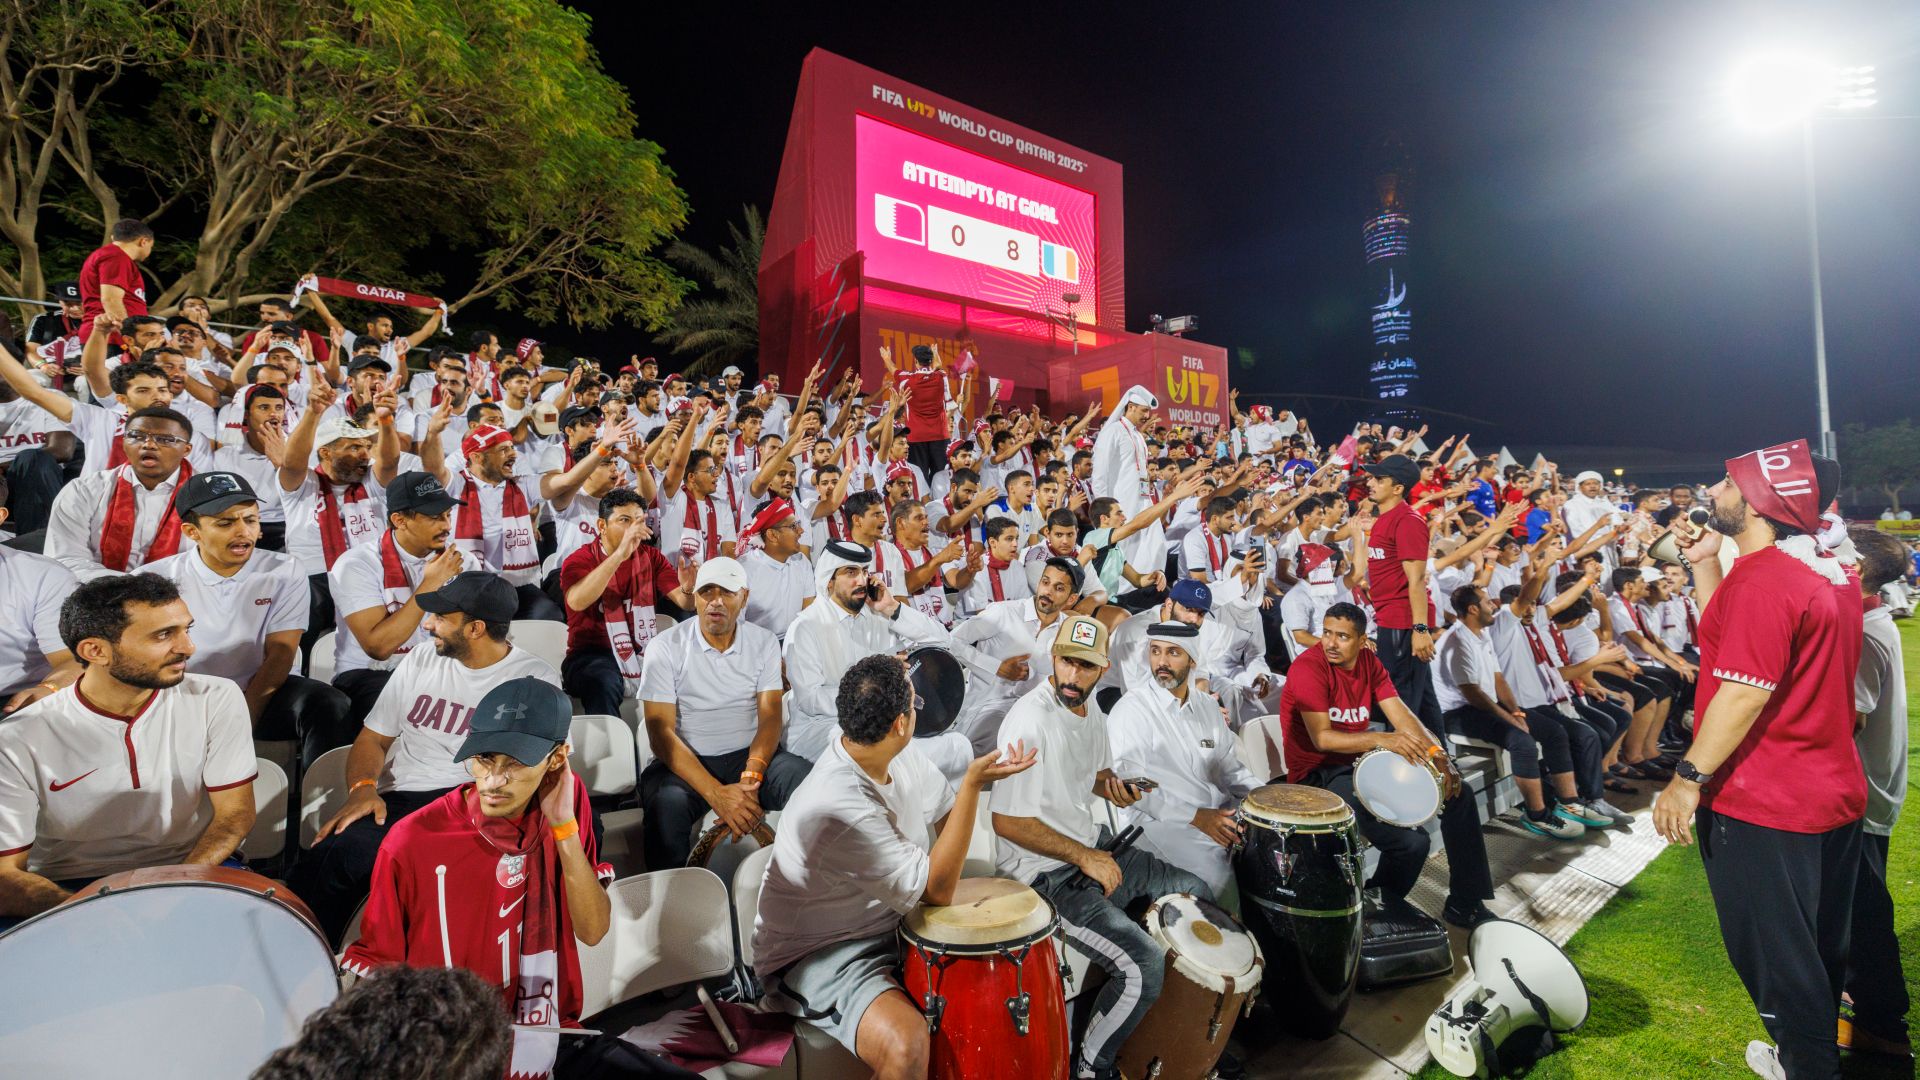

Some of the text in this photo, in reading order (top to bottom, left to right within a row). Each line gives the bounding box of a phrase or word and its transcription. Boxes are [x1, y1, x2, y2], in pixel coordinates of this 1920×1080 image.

[872, 84, 904, 109] FIFA
[907, 97, 936, 118] U17
[938, 109, 987, 138] WORLD
[989, 130, 1014, 147] CUP
[1016, 138, 1056, 164] QATAR
[903, 160, 1059, 225] ATTEMPTS AT GOAL
[951, 224, 965, 247] 0
[1007, 239, 1020, 261] 8
[66, 286, 78, 297] G
[356, 283, 406, 302] QATAR
[1182, 355, 1204, 371] FIFA
[1166, 366, 1219, 408] U17
[1169, 408, 1221, 427] WORLD CUP
[0, 431, 47, 447] TAR
[505, 527, 529, 538] مدرج
[504, 537, 532, 552] العنابي
[407, 694, 476, 737] QATA
[507, 873, 524, 887] QFA
